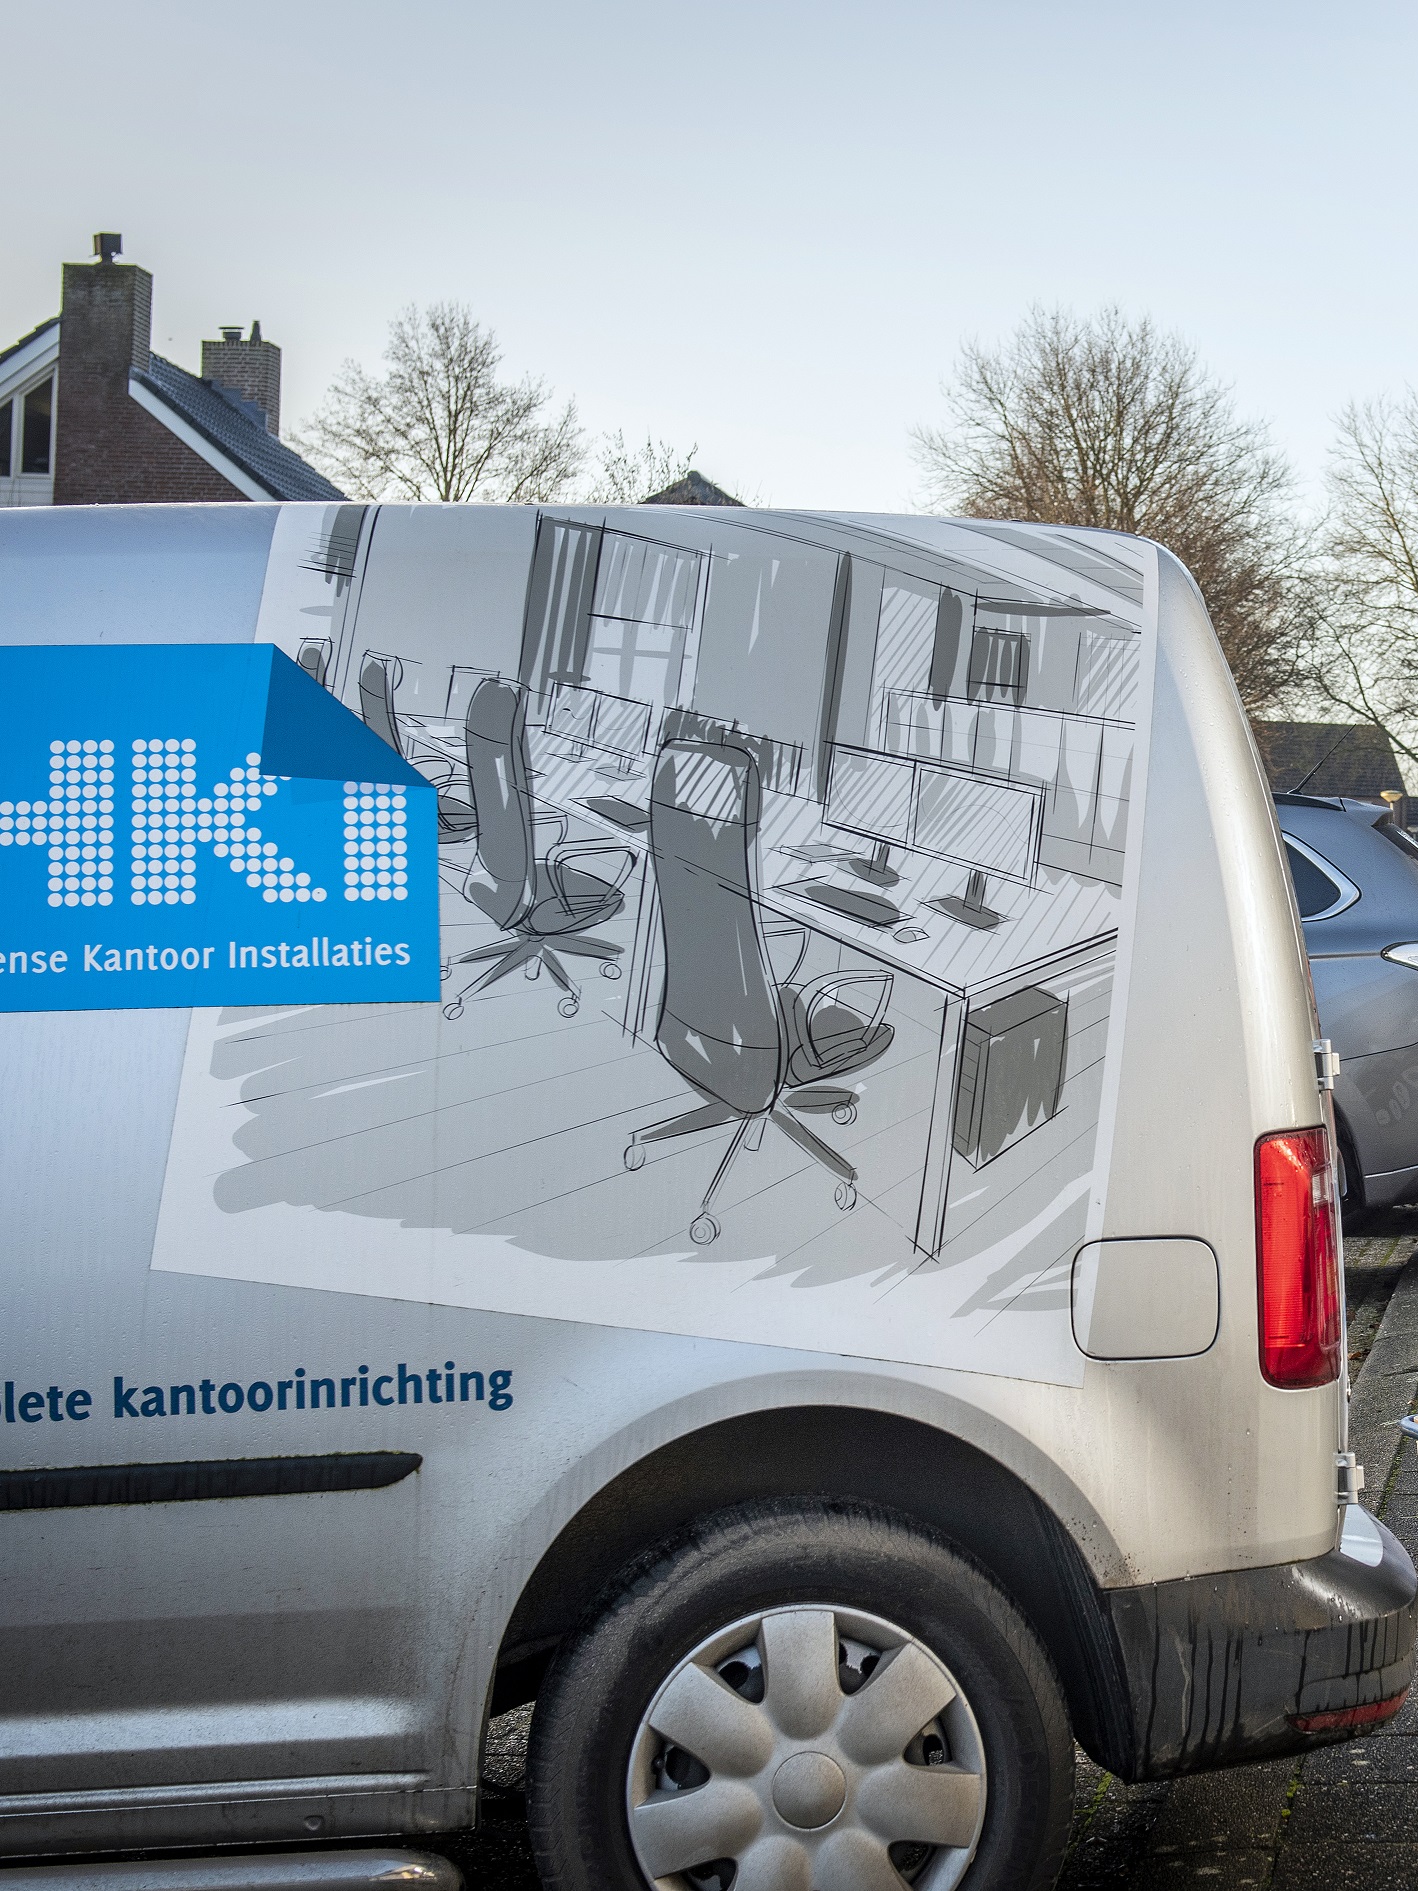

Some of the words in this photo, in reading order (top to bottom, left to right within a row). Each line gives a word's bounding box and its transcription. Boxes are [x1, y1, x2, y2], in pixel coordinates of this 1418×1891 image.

[82, 943, 215, 972] Kantoor
[228, 936, 411, 968] Installaties
[0, 1381, 93, 1423] lete
[112, 1360, 514, 1418] kantoorinrichting
